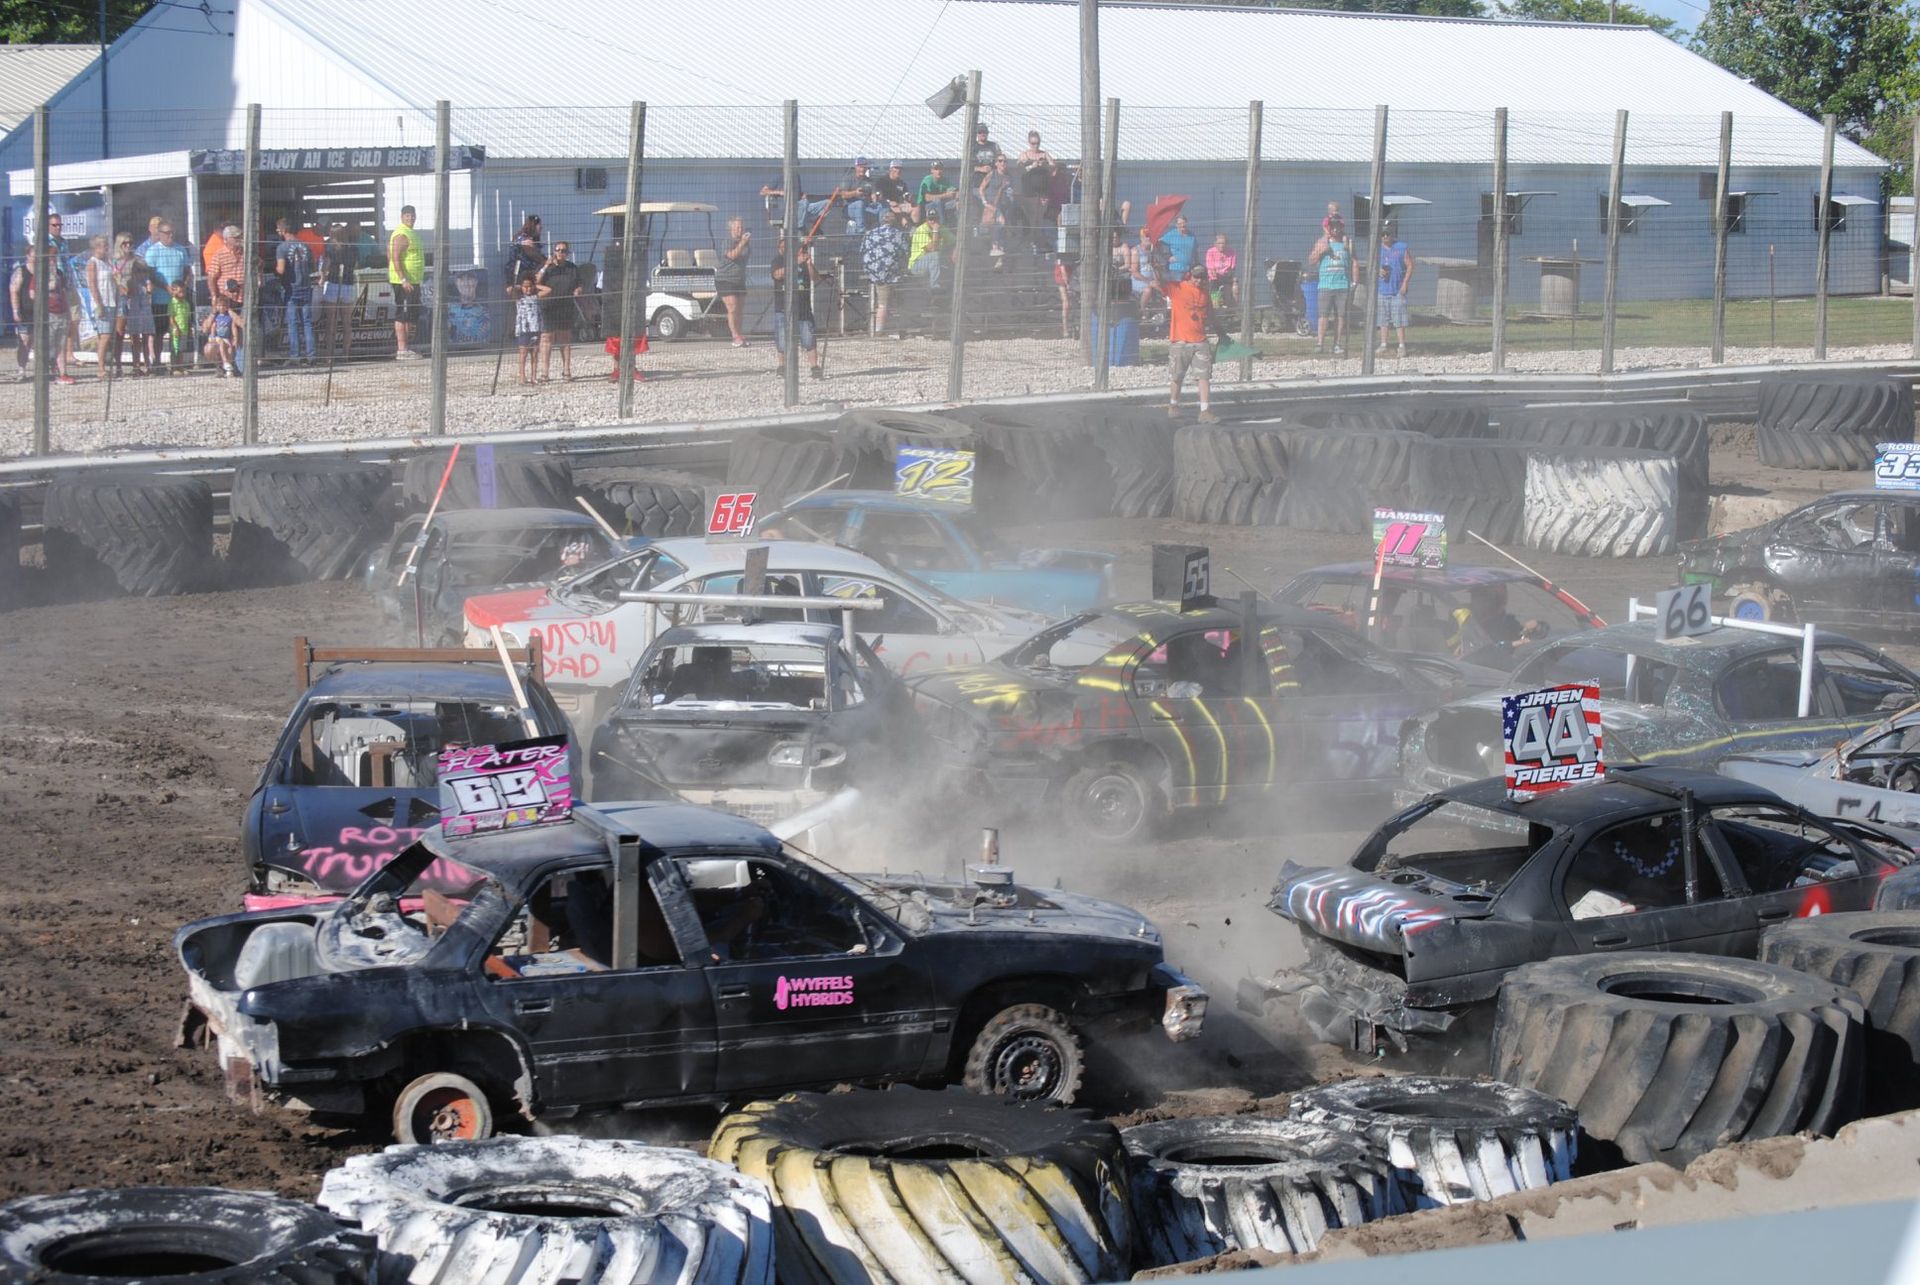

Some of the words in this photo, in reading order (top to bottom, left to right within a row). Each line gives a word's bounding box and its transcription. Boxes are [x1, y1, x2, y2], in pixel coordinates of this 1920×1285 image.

[259, 151, 298, 169] ENJOY
[303, 152, 321, 168] AN
[327, 152, 345, 168] ICE
[351, 151, 382, 167] COLD
[388, 150, 422, 166] BEER!
[898, 460, 974, 496] 12
[1374, 510, 1446, 523] HAMMEN
[1183, 556, 1209, 599] 55
[1665, 586, 1708, 639] 66
[530, 619, 617, 655] MOM
[542, 652, 601, 680] DAD
[1519, 688, 1585, 708] JAREN
[1511, 702, 1598, 768] 44
[446, 744, 562, 772] FLATER
[1514, 762, 1598, 787] PIERCE
[790, 976, 854, 991] WYFFELS
[791, 991, 854, 1007] HYBRIDS
